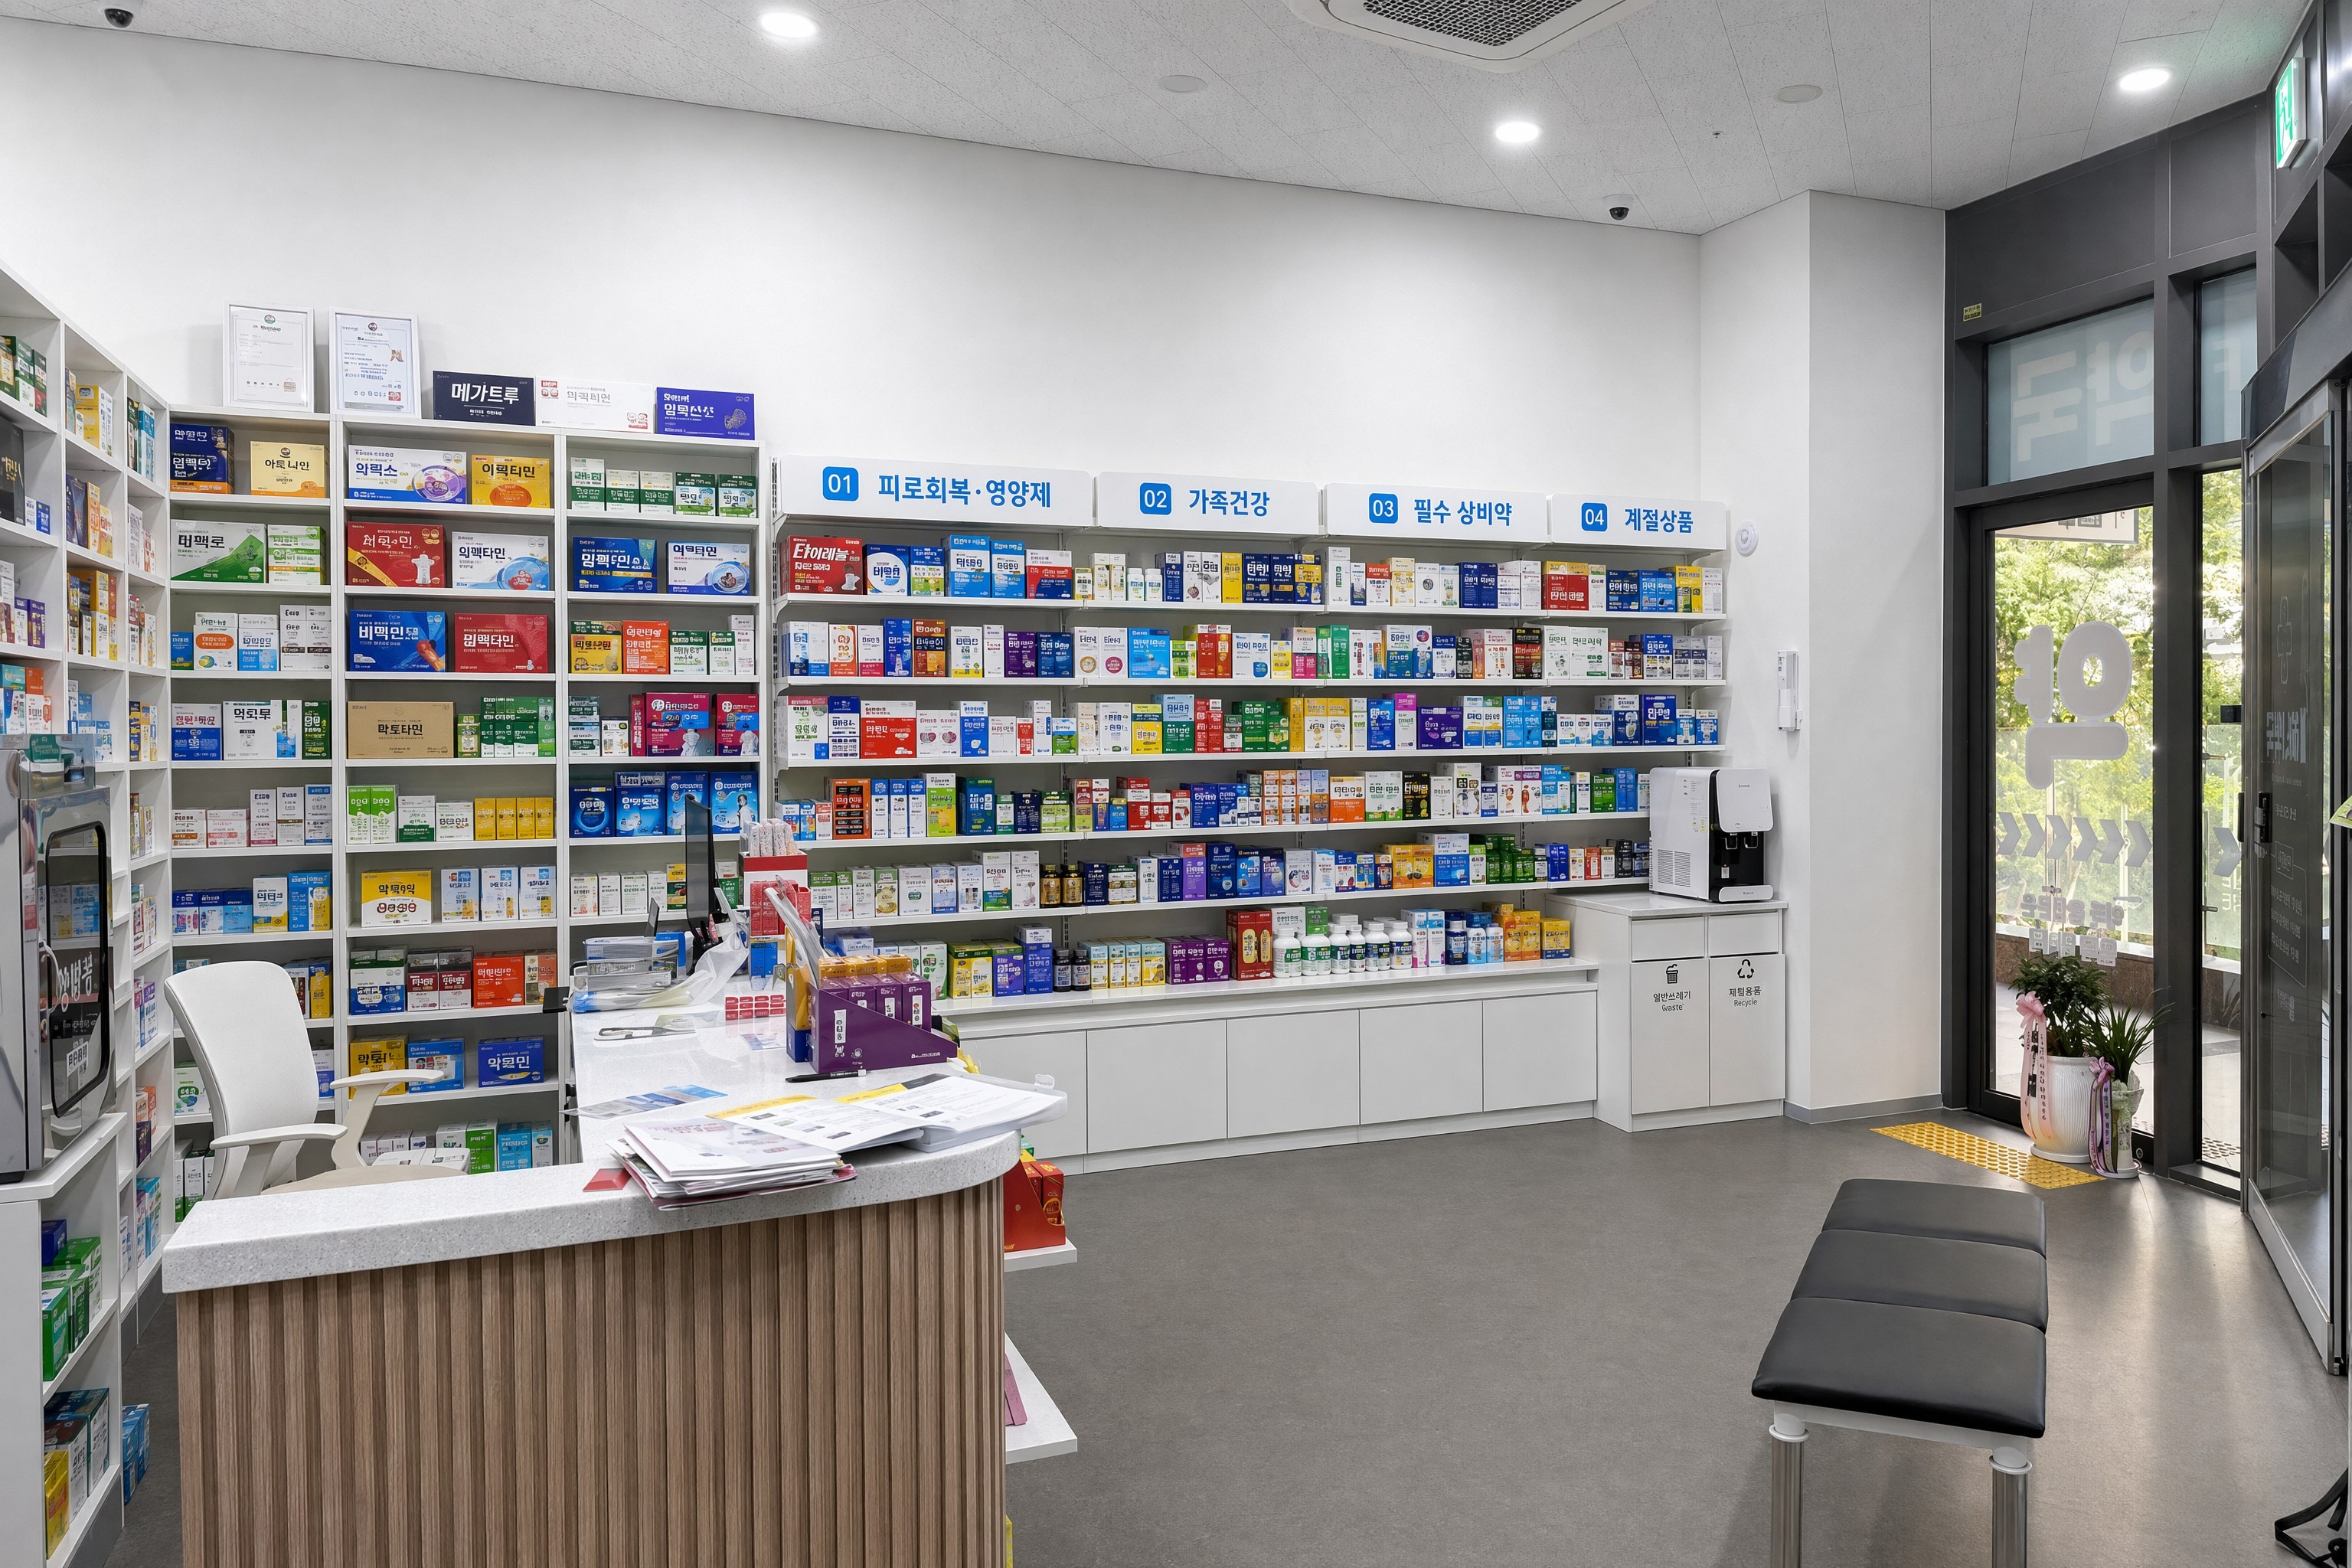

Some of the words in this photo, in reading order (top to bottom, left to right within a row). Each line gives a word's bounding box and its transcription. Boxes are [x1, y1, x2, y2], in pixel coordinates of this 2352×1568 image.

[451, 383, 520, 404] 메가트루
[828, 474, 852, 495] 01
[878, 474, 1051, 508] 피로회복·영양제
[1144, 489, 1168, 508] 02
[1189, 488, 1271, 518] 가족건강
[1373, 499, 1394, 518] 03
[1414, 499, 1451, 524] 필수
[1457, 501, 1513, 527] 상비약
[1585, 508, 1605, 526] 04
[1625, 508, 1694, 534] 계절상품
